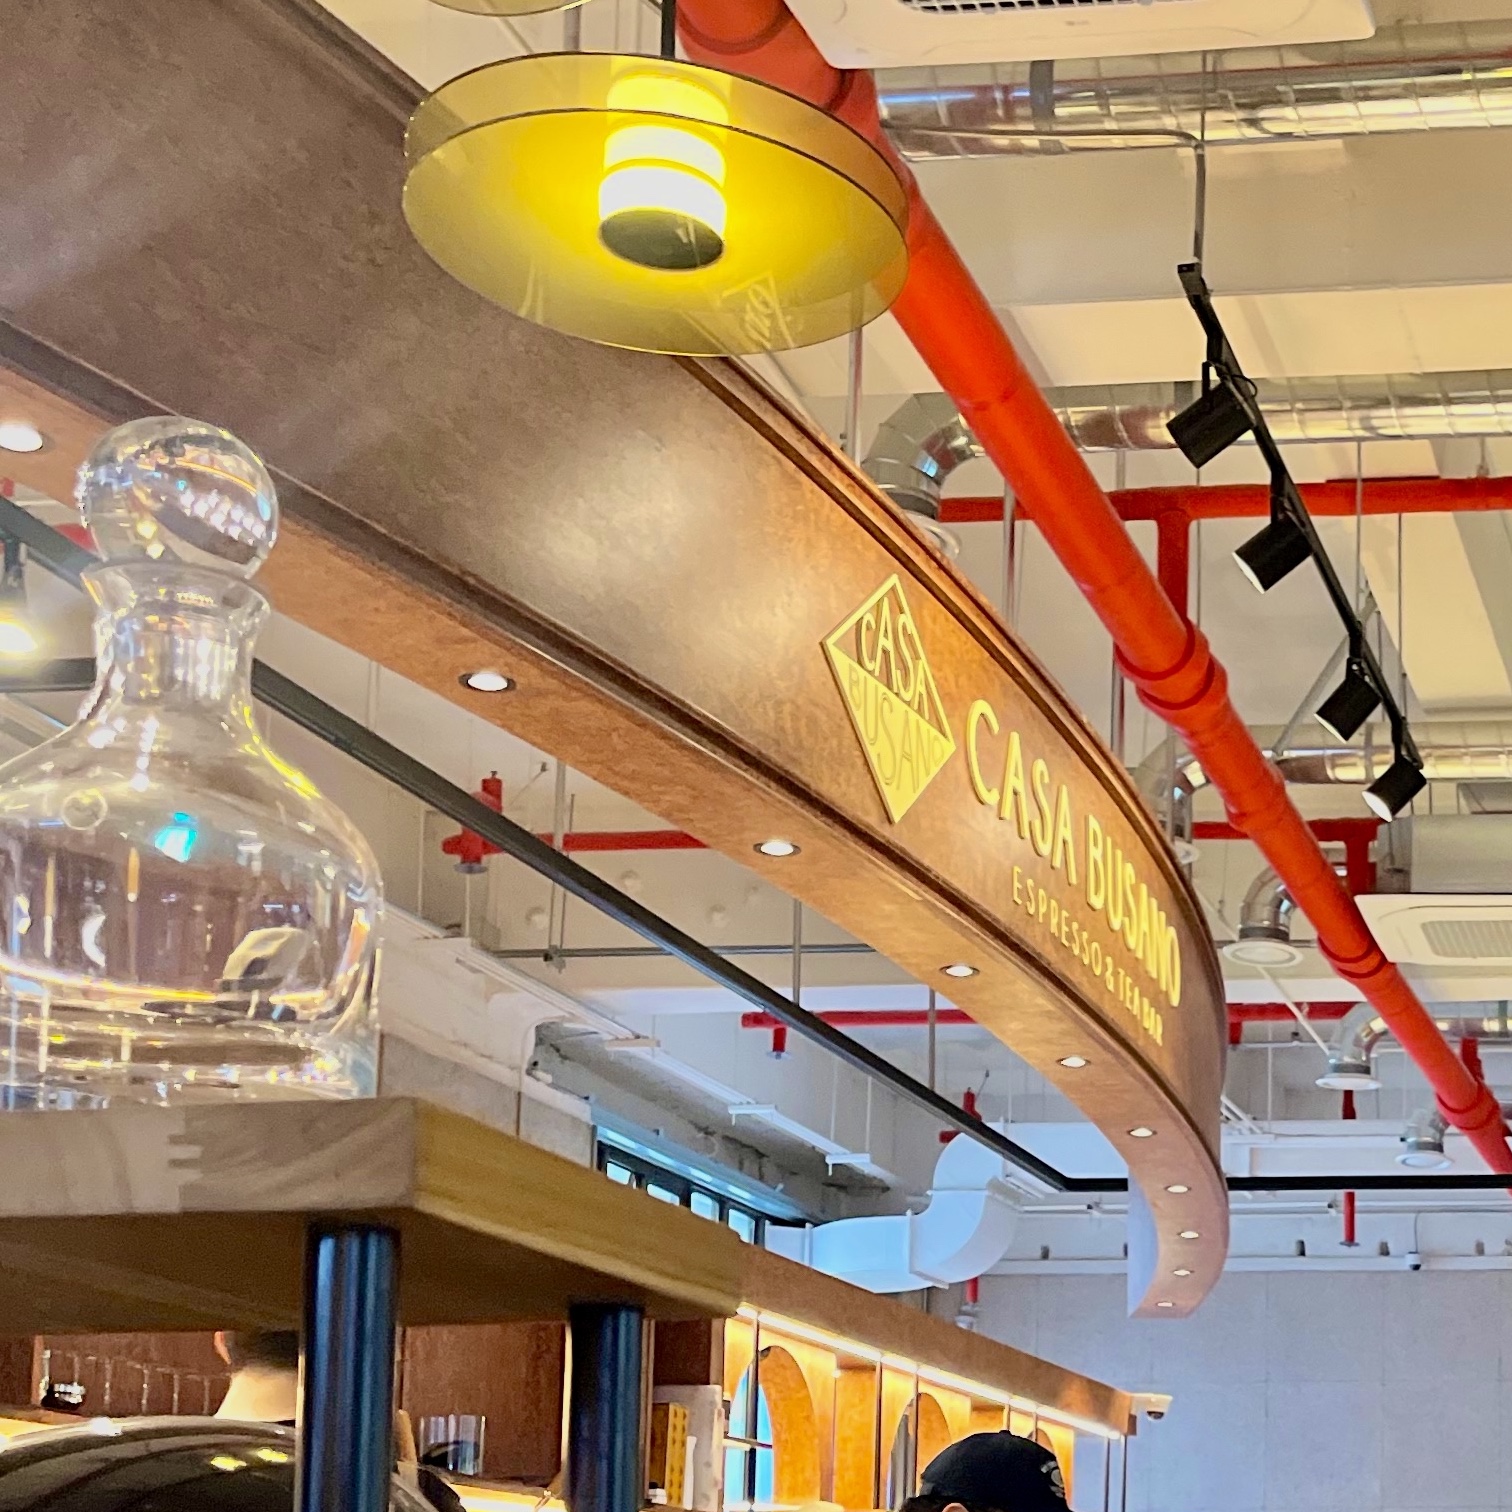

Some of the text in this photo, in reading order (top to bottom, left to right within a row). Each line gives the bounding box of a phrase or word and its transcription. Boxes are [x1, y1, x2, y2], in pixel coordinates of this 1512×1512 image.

[848, 662, 945, 794] BUSANO
[860, 596, 930, 720] CASA
[966, 699, 1182, 1007] CASA BUSANO
[1012, 865, 1163, 1046] ESPRESSO & TEA BAR
